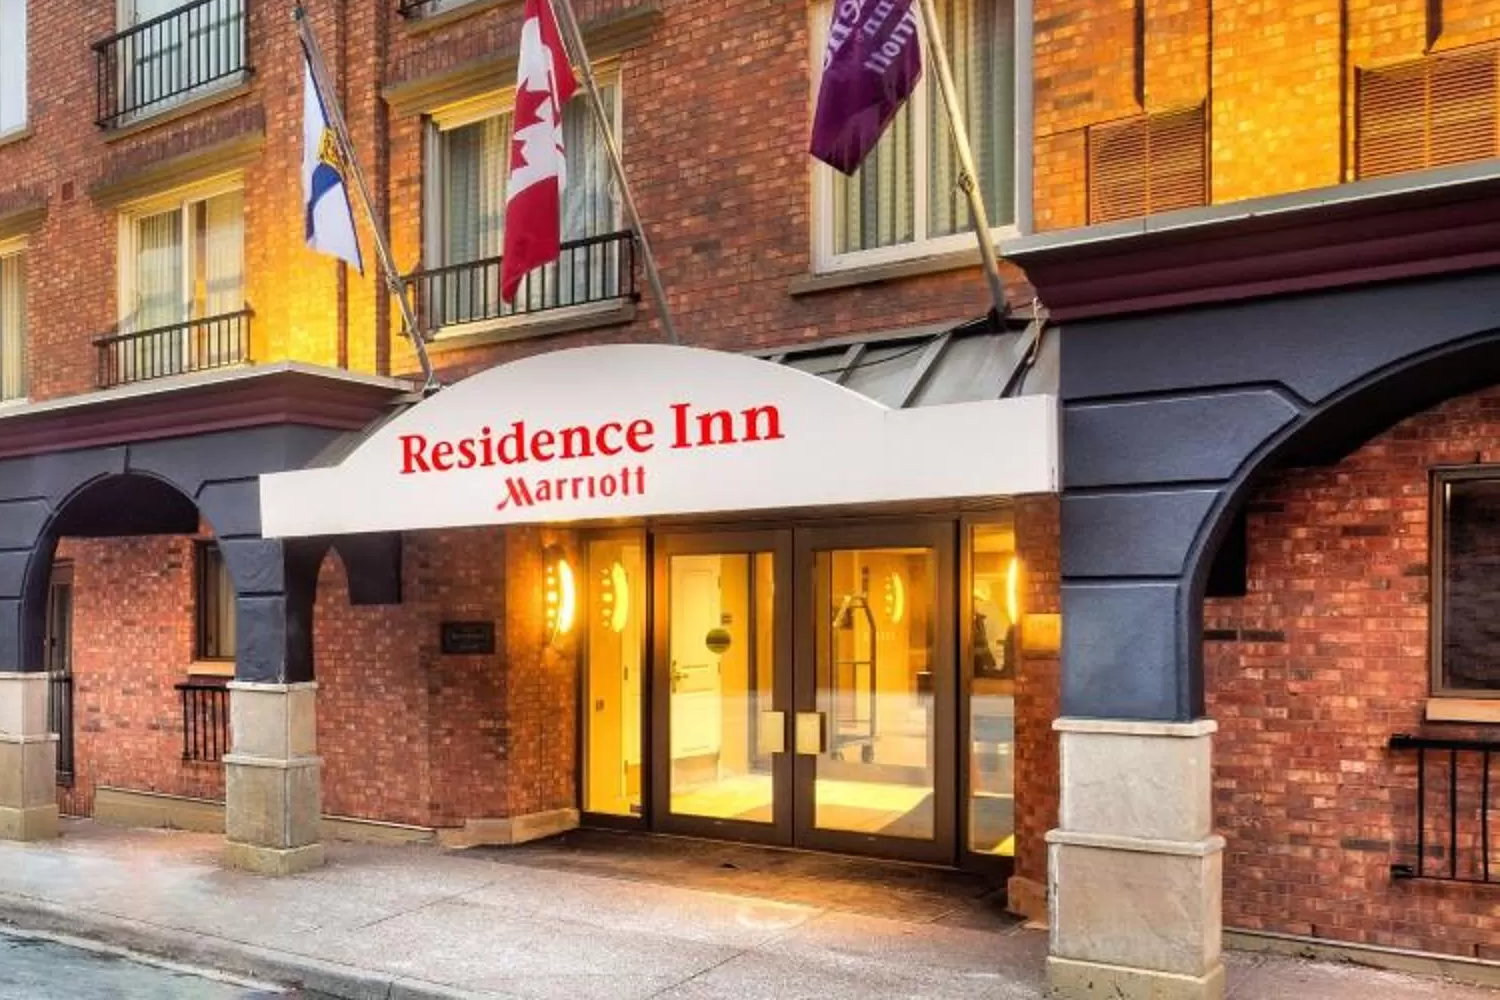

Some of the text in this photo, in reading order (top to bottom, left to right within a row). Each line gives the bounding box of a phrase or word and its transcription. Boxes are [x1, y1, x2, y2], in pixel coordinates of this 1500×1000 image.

[398, 401, 785, 475] Residence Inn
[496, 465, 647, 511] Marriott
